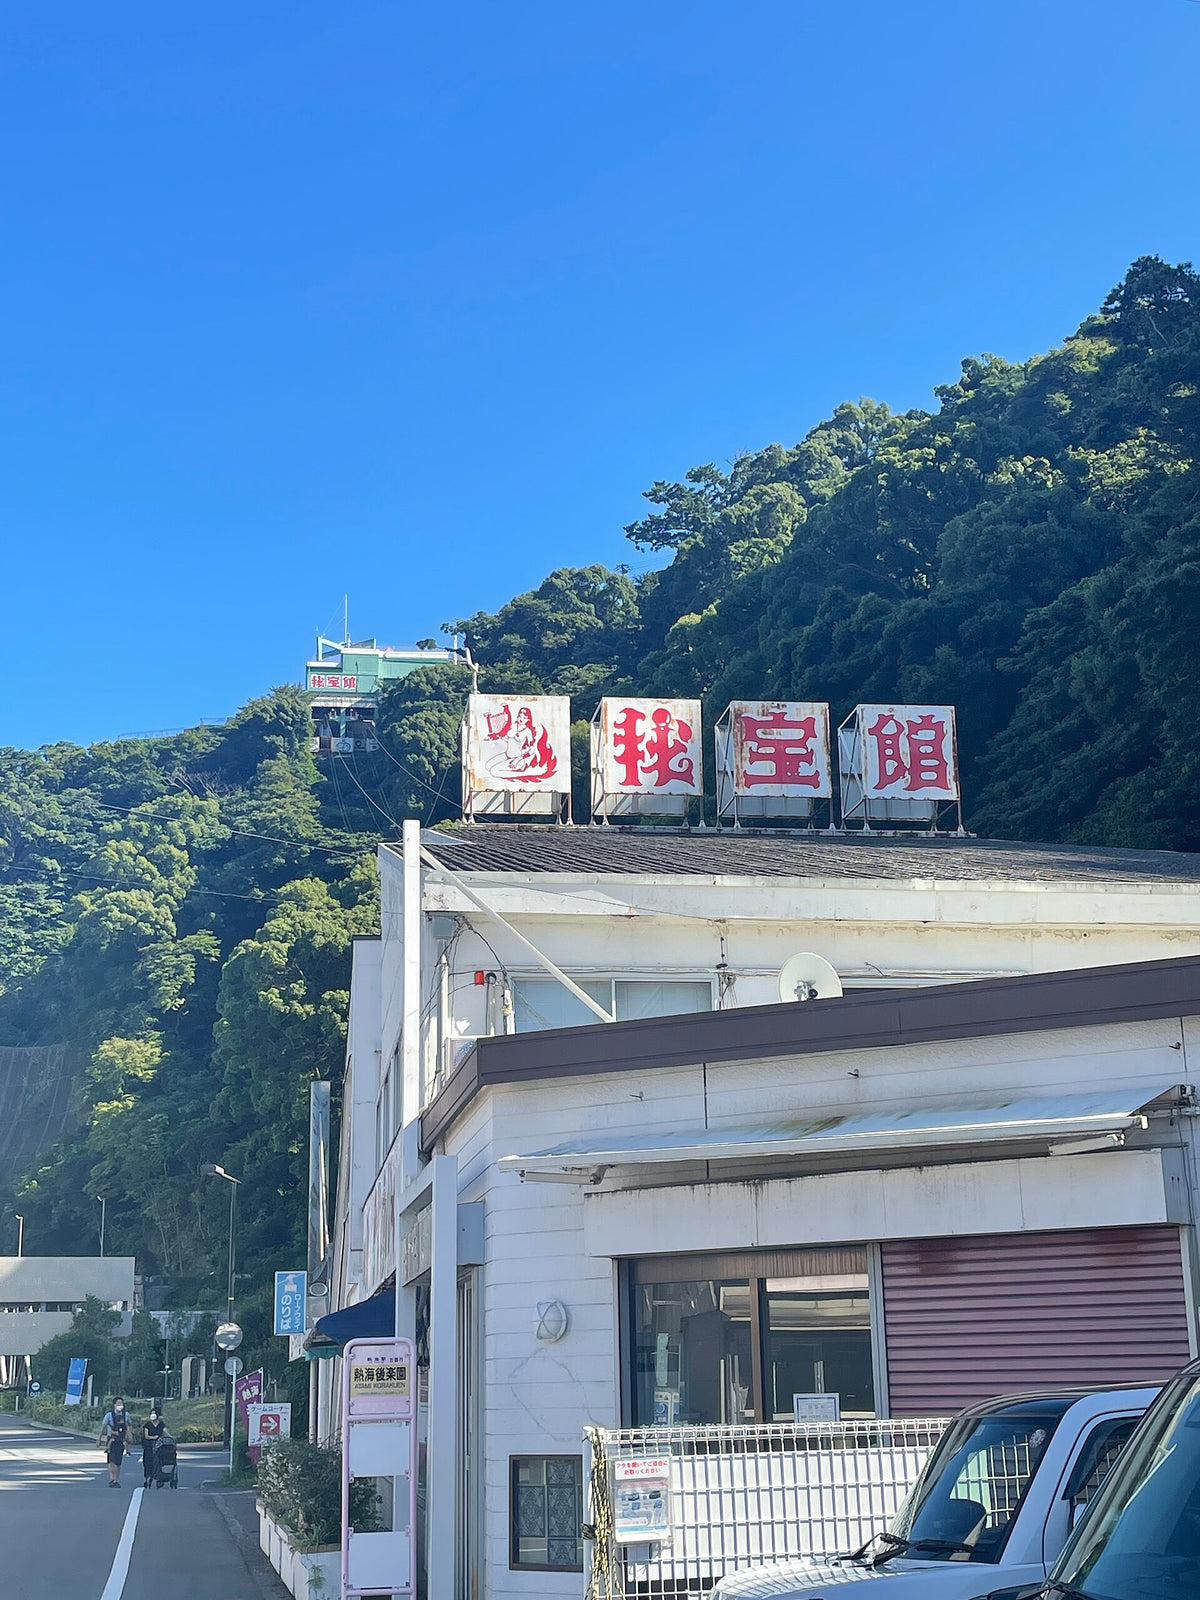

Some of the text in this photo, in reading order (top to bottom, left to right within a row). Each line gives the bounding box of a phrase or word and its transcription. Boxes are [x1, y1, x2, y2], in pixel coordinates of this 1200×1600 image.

[311, 675, 356, 688] 秘宝館
[613, 707, 950, 791] 秘宝館
[281, 1294, 292, 1331] のりば
[354, 1366, 407, 1382] 熱海後楽園
[373, 1381, 406, 1389] KORAKUEN
